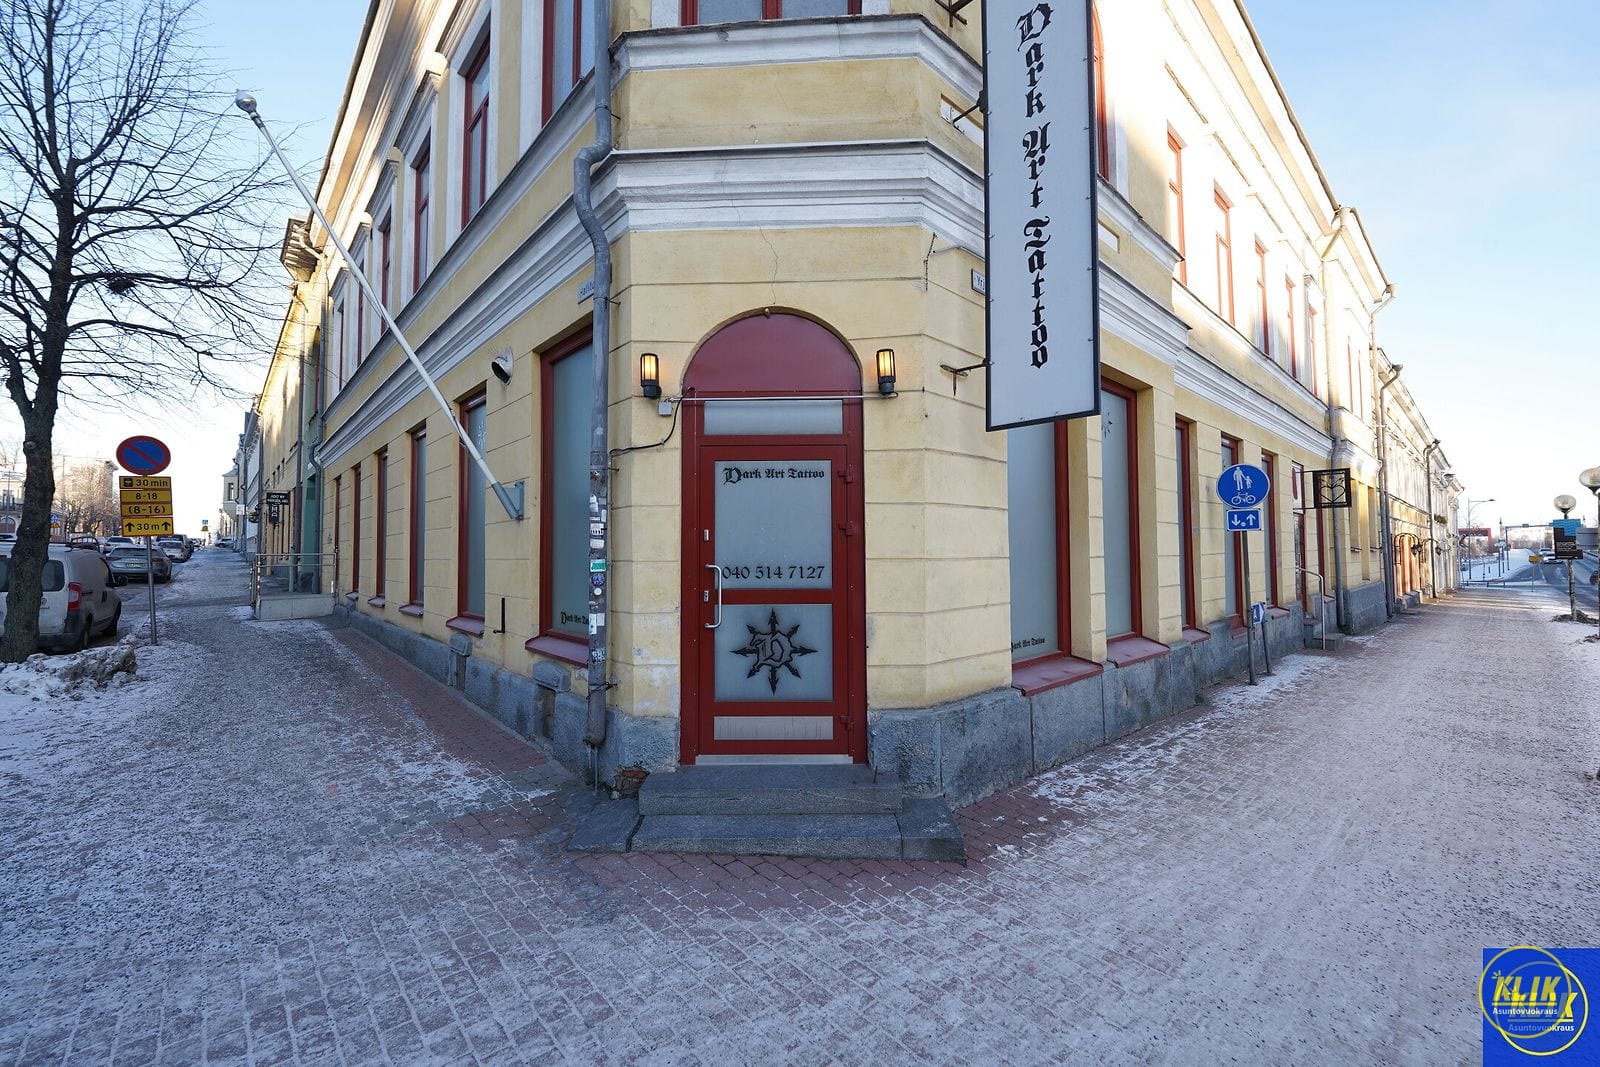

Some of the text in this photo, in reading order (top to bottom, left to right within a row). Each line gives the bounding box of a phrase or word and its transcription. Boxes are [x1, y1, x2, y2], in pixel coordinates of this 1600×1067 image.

[1014, 3, 1054, 369] Dark Art Tattoo
[723, 467, 825, 485] Dark Art Tattoo
[136, 479, 168, 487] 30 min
[129, 505, 165, 514] (8-16)
[137, 523, 149, 531] 30
[722, 566, 825, 579] 040 514 7127
